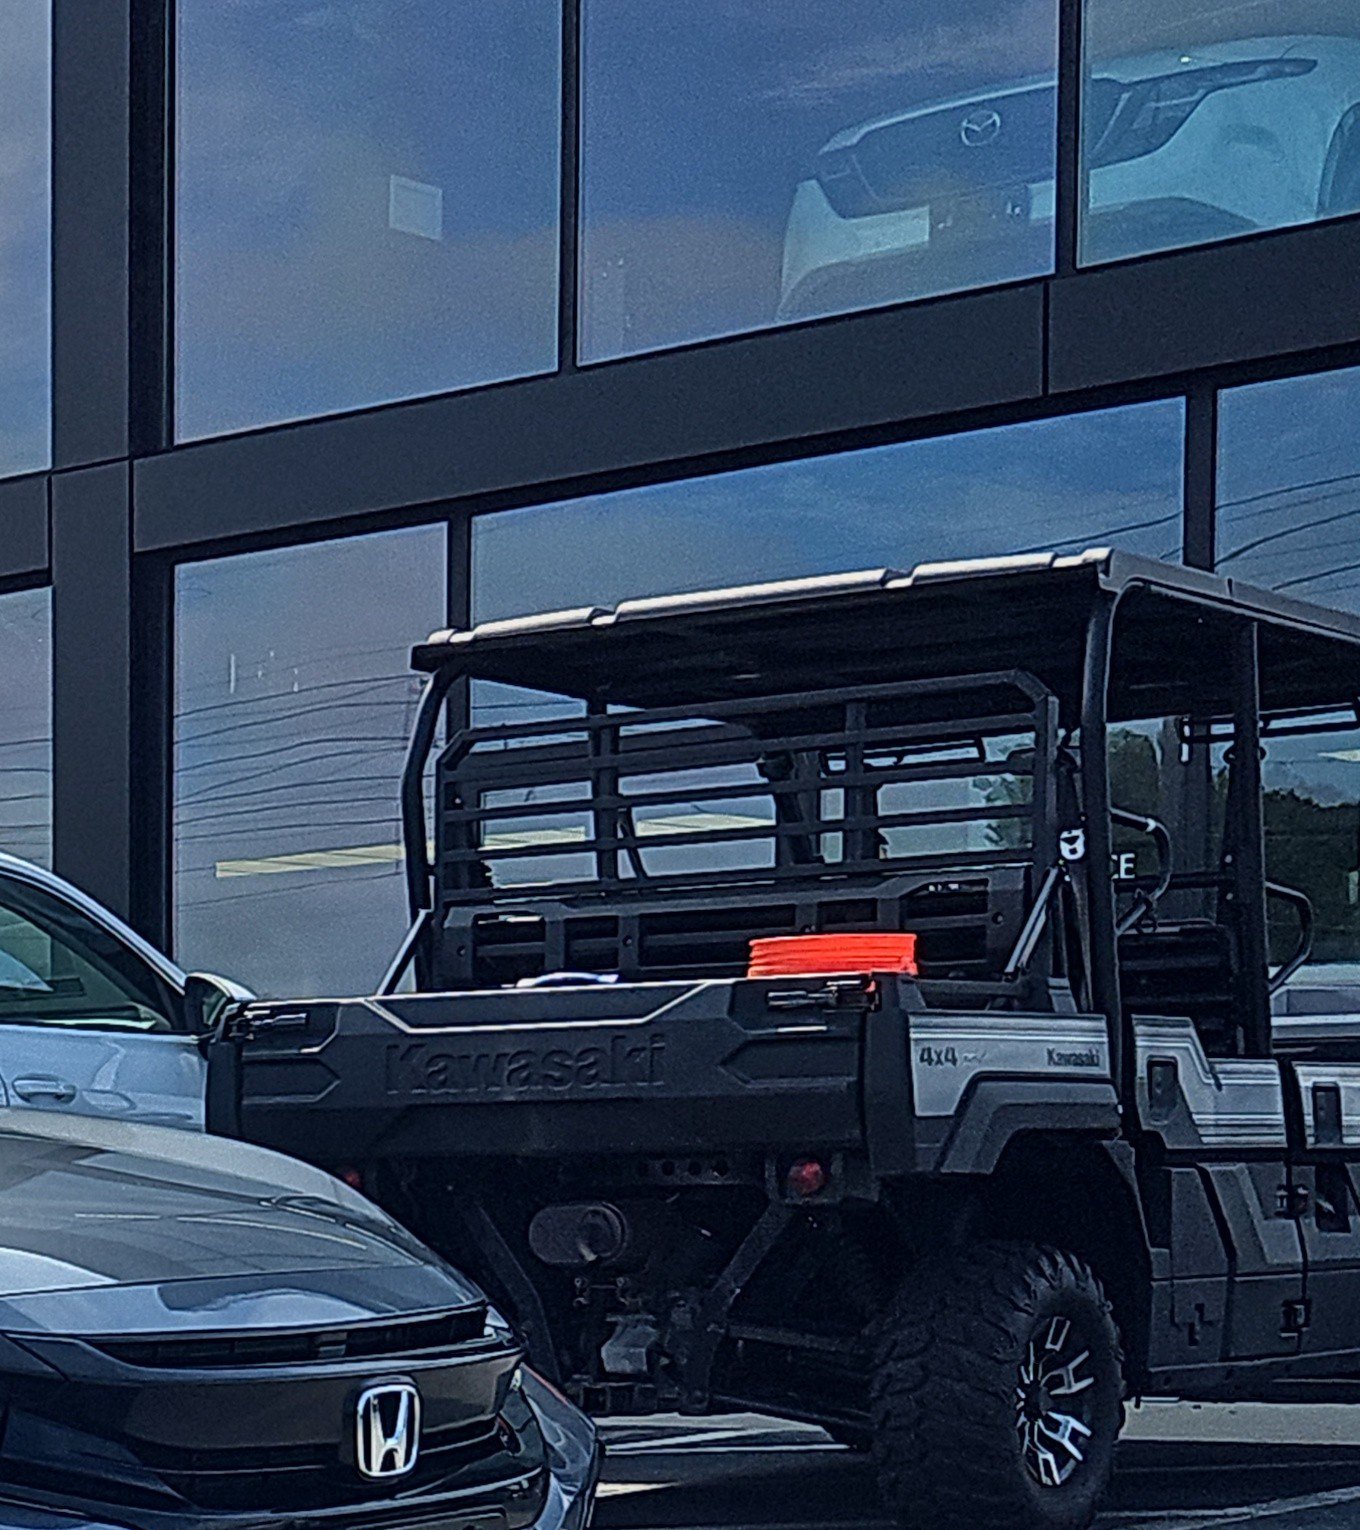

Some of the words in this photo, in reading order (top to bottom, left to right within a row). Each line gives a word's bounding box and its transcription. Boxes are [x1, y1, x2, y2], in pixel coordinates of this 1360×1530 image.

[384, 1033, 668, 1095] Kawasaki
[919, 1047, 958, 1067] 4x4
[1047, 1048, 1101, 1067] Kawasaki
